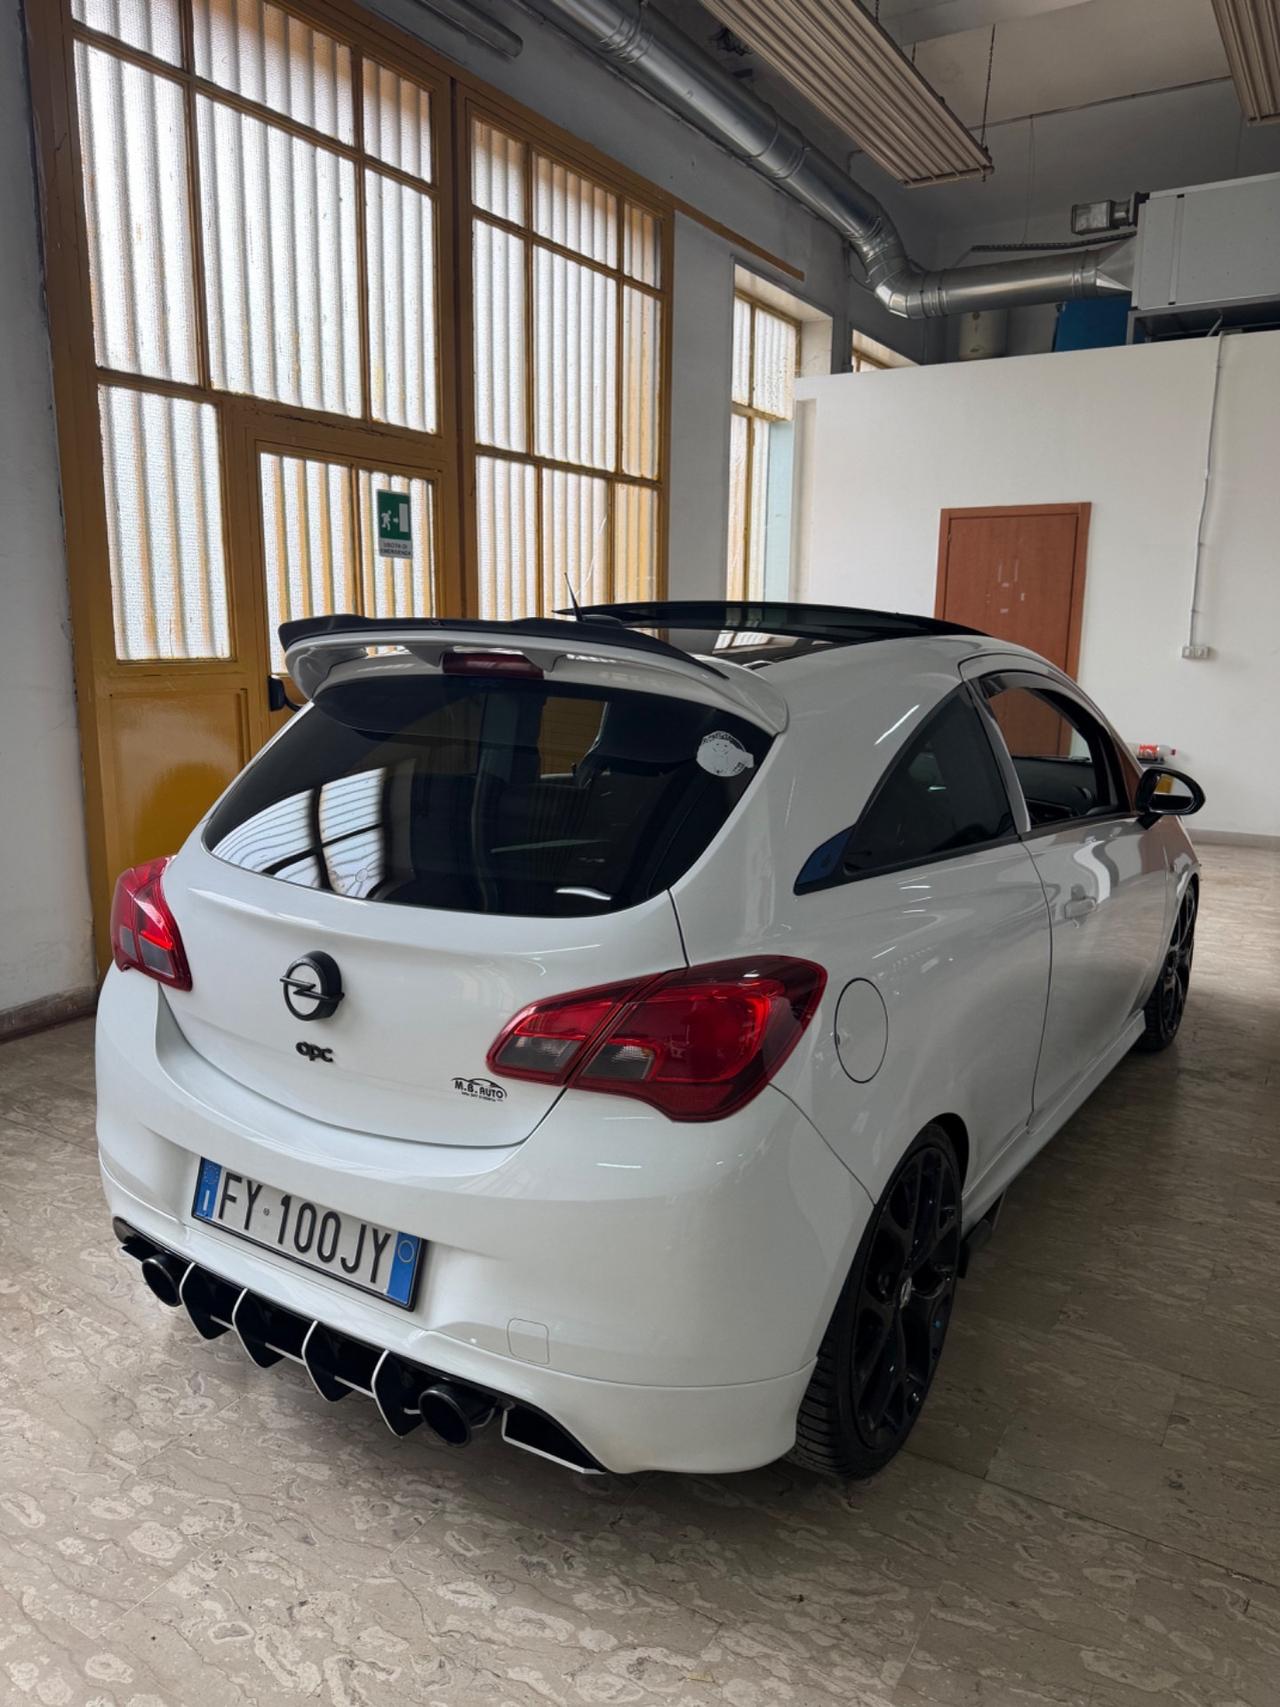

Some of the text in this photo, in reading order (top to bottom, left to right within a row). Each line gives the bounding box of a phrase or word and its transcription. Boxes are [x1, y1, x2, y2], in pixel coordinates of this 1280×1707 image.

[479, 1086, 504, 1098] AUTO
[218, 1171, 263, 1230] FY
[277, 1194, 392, 1284] 100JY
